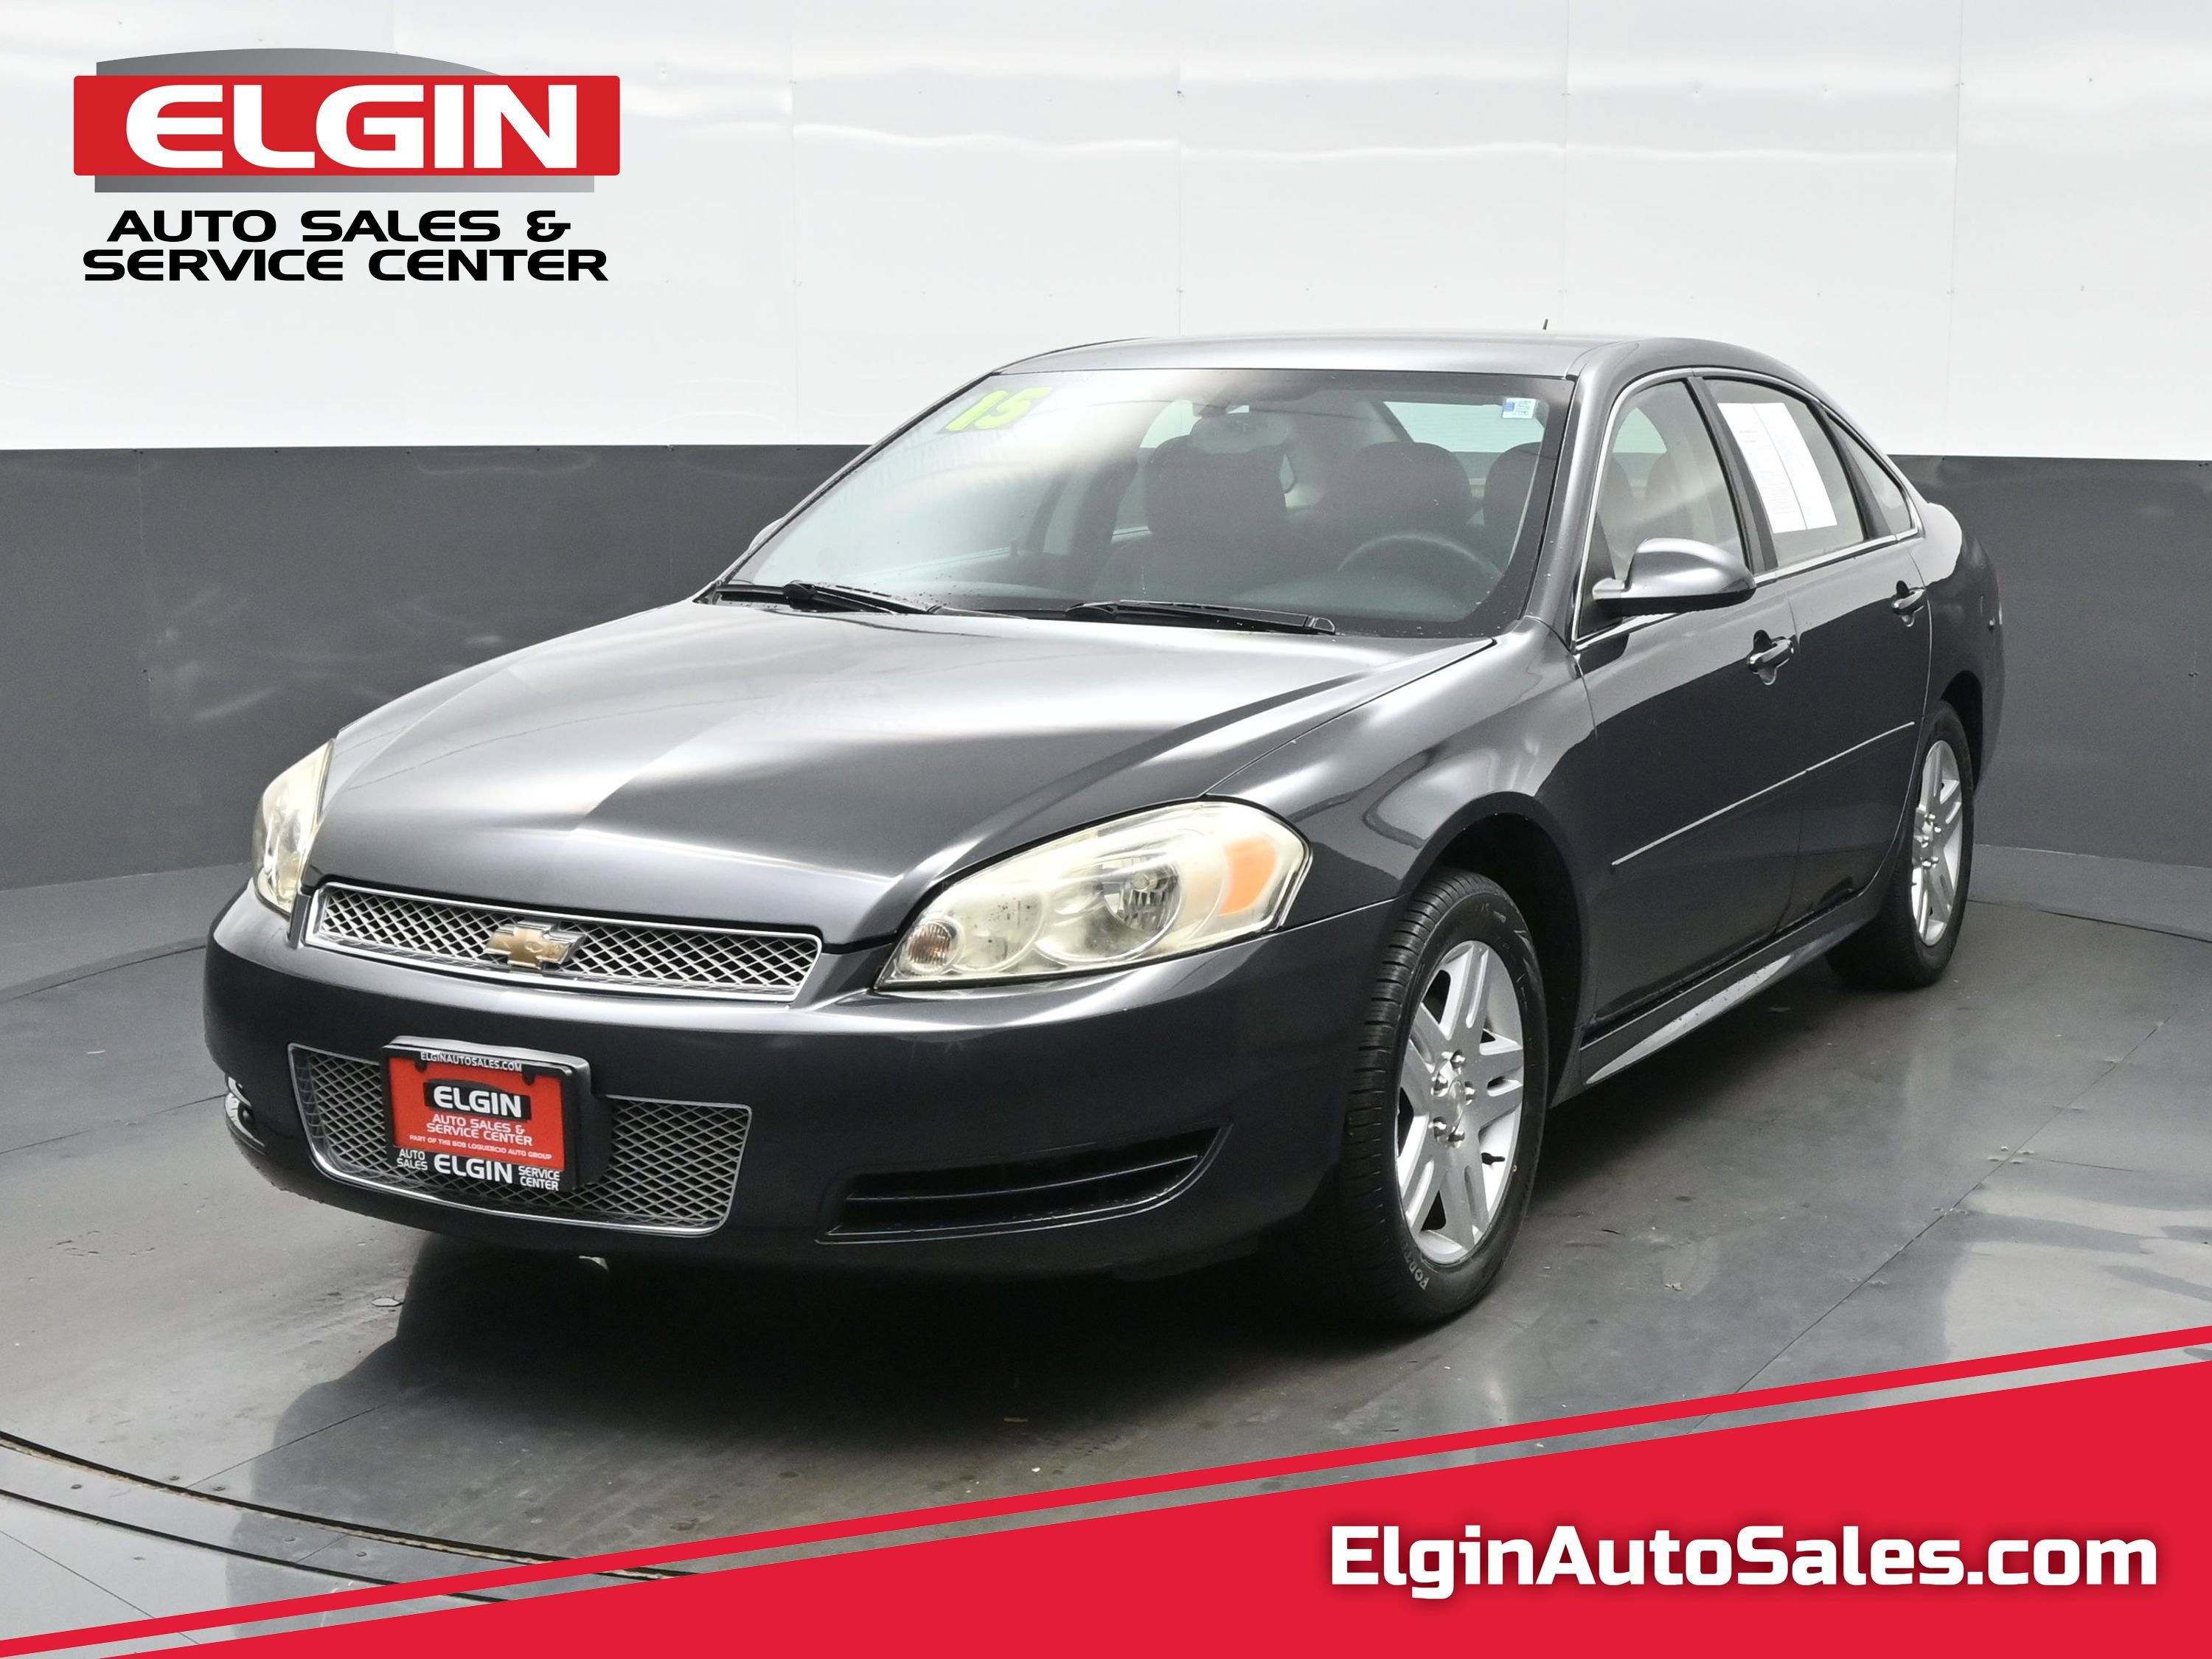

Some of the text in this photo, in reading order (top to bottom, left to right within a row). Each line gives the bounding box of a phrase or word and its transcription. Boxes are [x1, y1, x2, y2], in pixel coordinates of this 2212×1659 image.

[945, 386, 1053, 431] 15
[420, 1051, 522, 1071] ELGINAUTOSALES.COM
[433, 1085, 522, 1118] ELGIN
[426, 1122, 532, 1147] SERVICE CENTER
[432, 1113, 526, 1135] AUTO SALES &
[399, 1148, 425, 1161] AUTO
[409, 1134, 425, 1143] PART
[452, 1140, 467, 1148] BOB
[508, 1148, 526, 1157] AUTO
[528, 1151, 552, 1160] GROUP
[396, 1157, 428, 1172] SALES
[434, 1154, 512, 1183] ELGIN
[518, 1165, 560, 1181] SERVICE
[520, 1177, 559, 1192] CENTER
